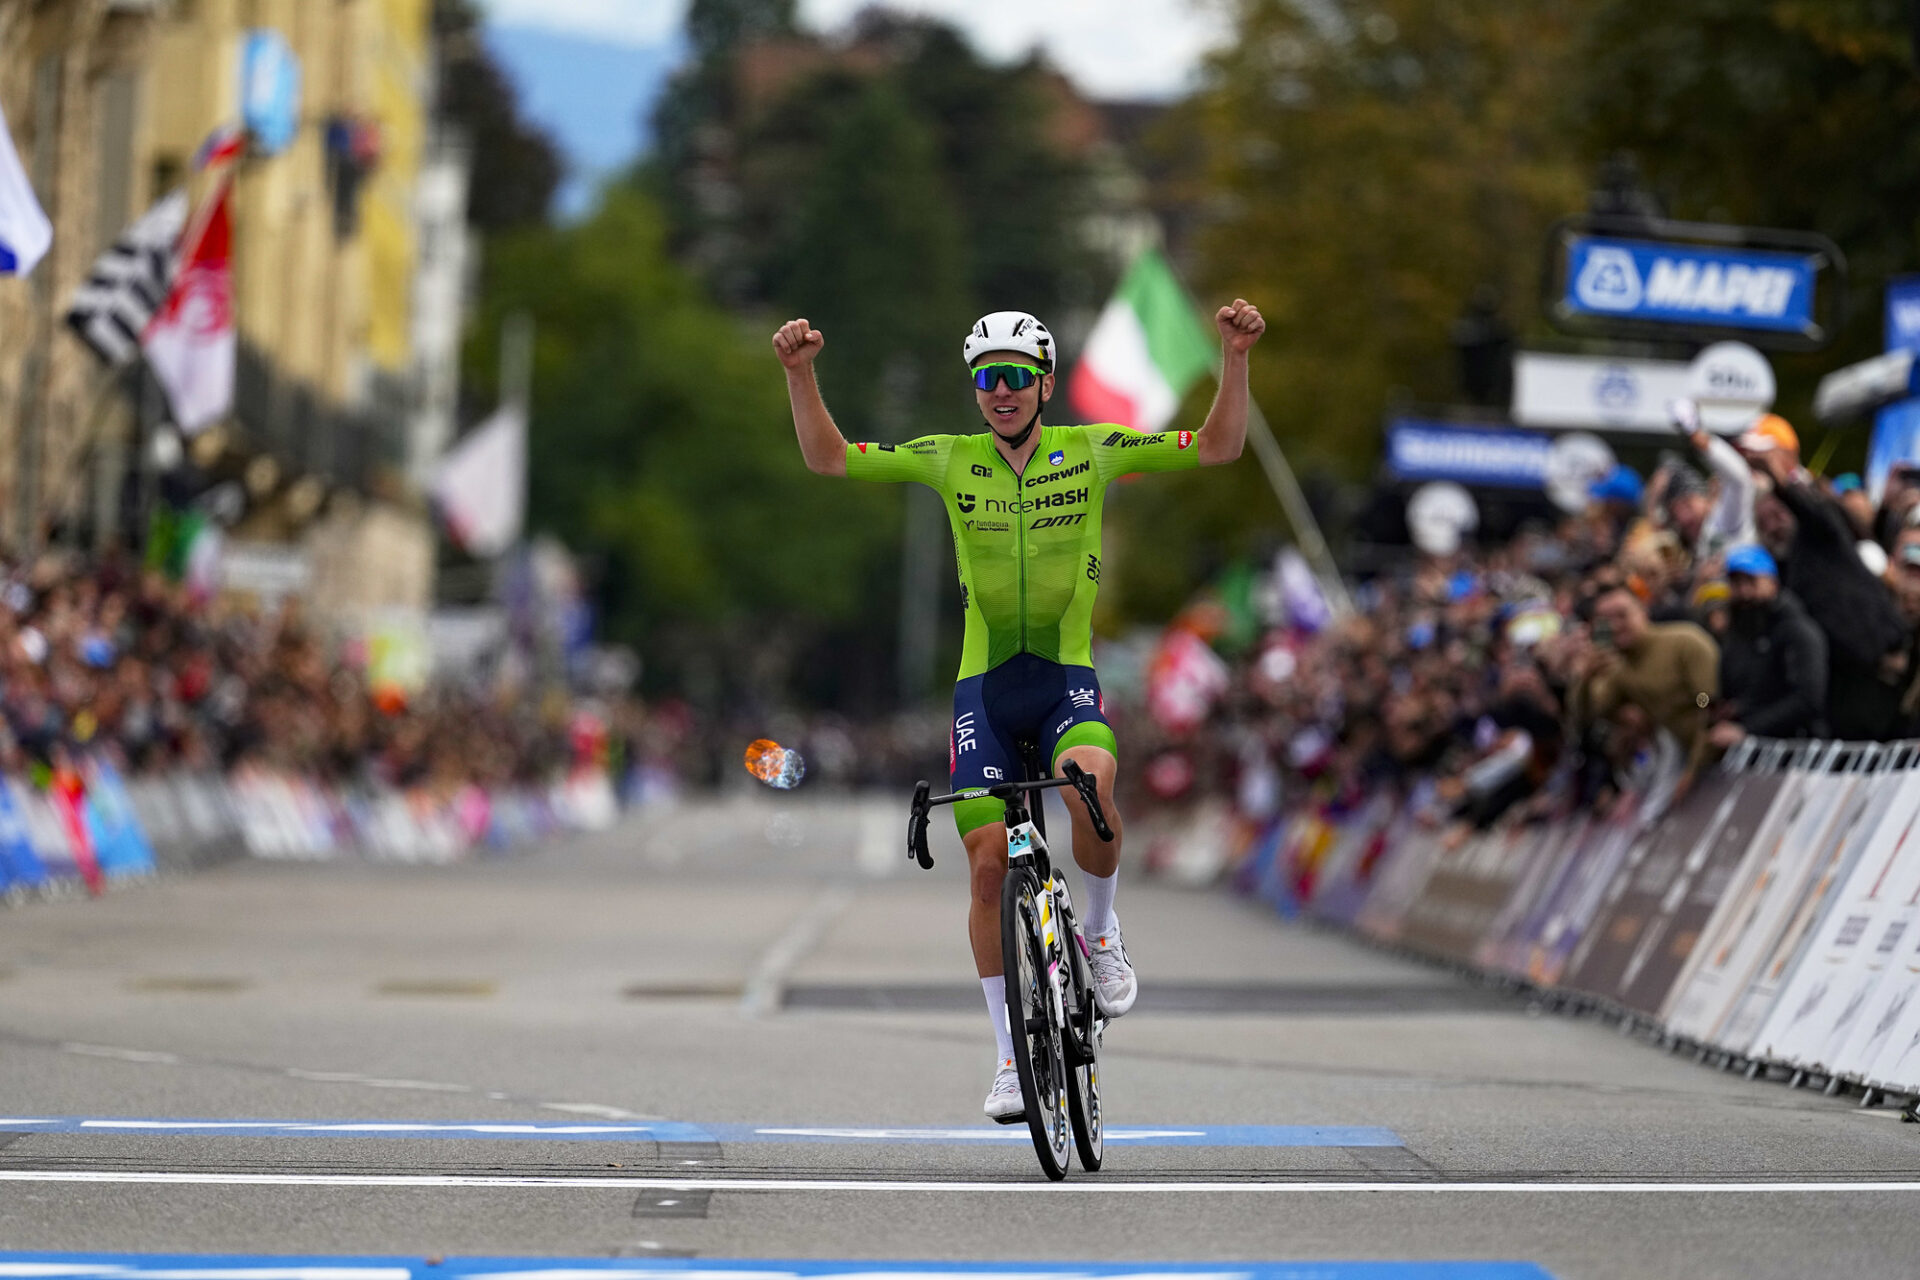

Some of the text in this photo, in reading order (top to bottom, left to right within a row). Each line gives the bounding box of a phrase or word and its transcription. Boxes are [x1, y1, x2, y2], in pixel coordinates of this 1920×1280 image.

[1646, 257, 1795, 317] MAPEI
[1025, 460, 1090, 488] CORWIN
[1029, 513, 1087, 530] DMT
[1069, 687, 1095, 709] UAE
[955, 711, 977, 755] UAE
